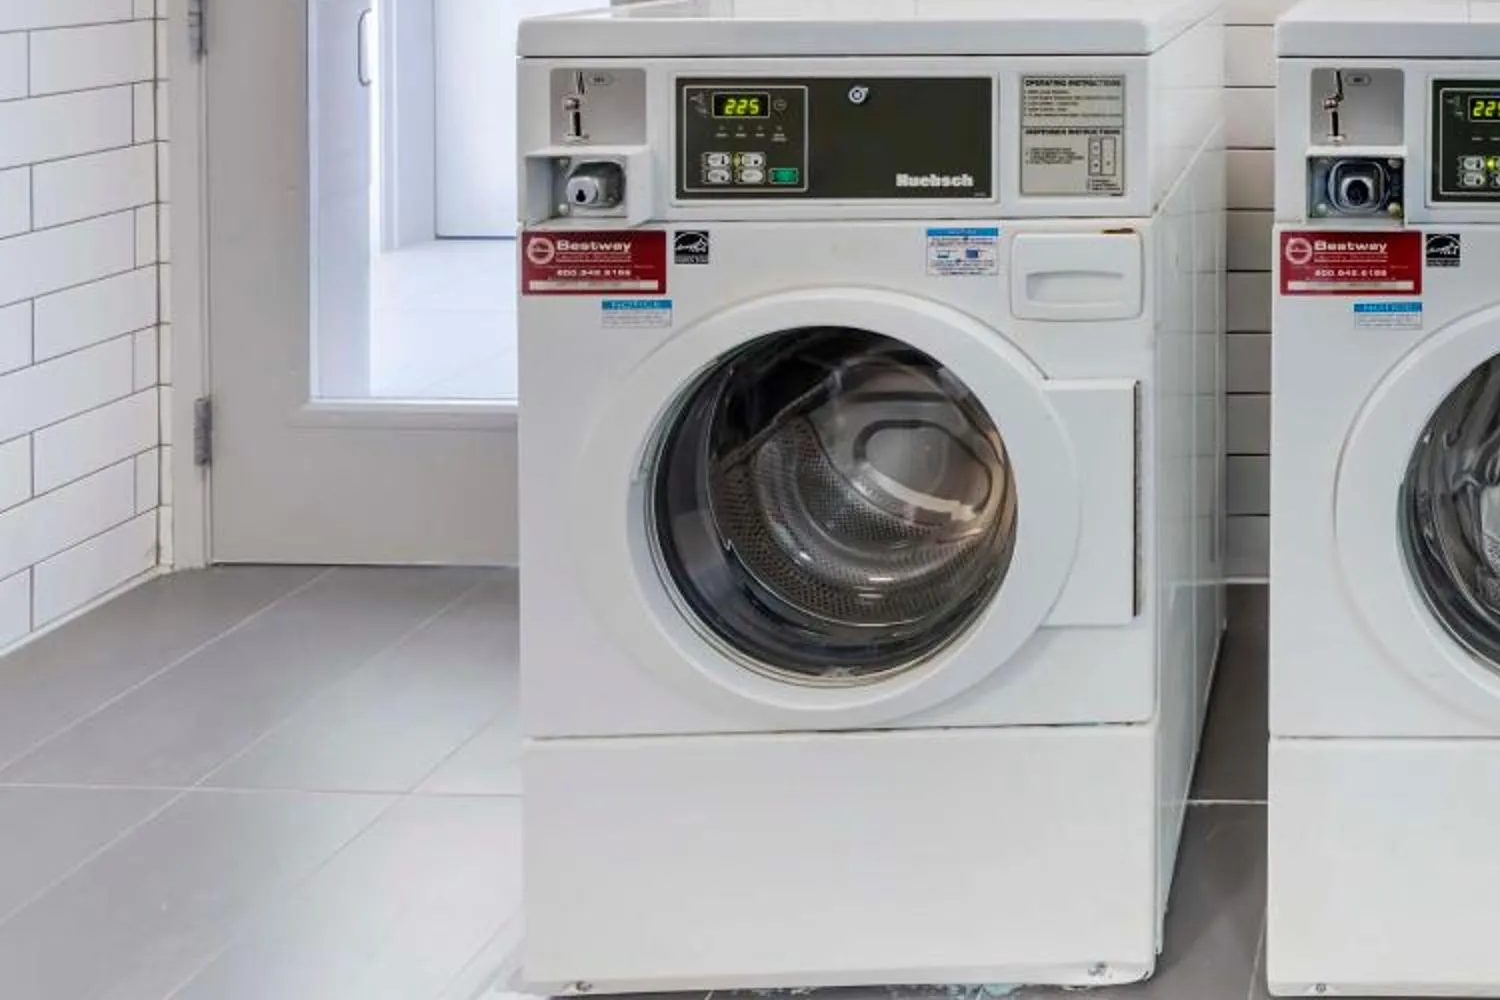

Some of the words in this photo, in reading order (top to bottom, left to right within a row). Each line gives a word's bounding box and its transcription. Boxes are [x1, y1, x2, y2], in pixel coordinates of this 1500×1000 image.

[724, 98, 760, 115] 225
[896, 173, 974, 187] Huebsch
[556, 239, 632, 252] Bestway
[1313, 239, 1388, 253] Bestway
